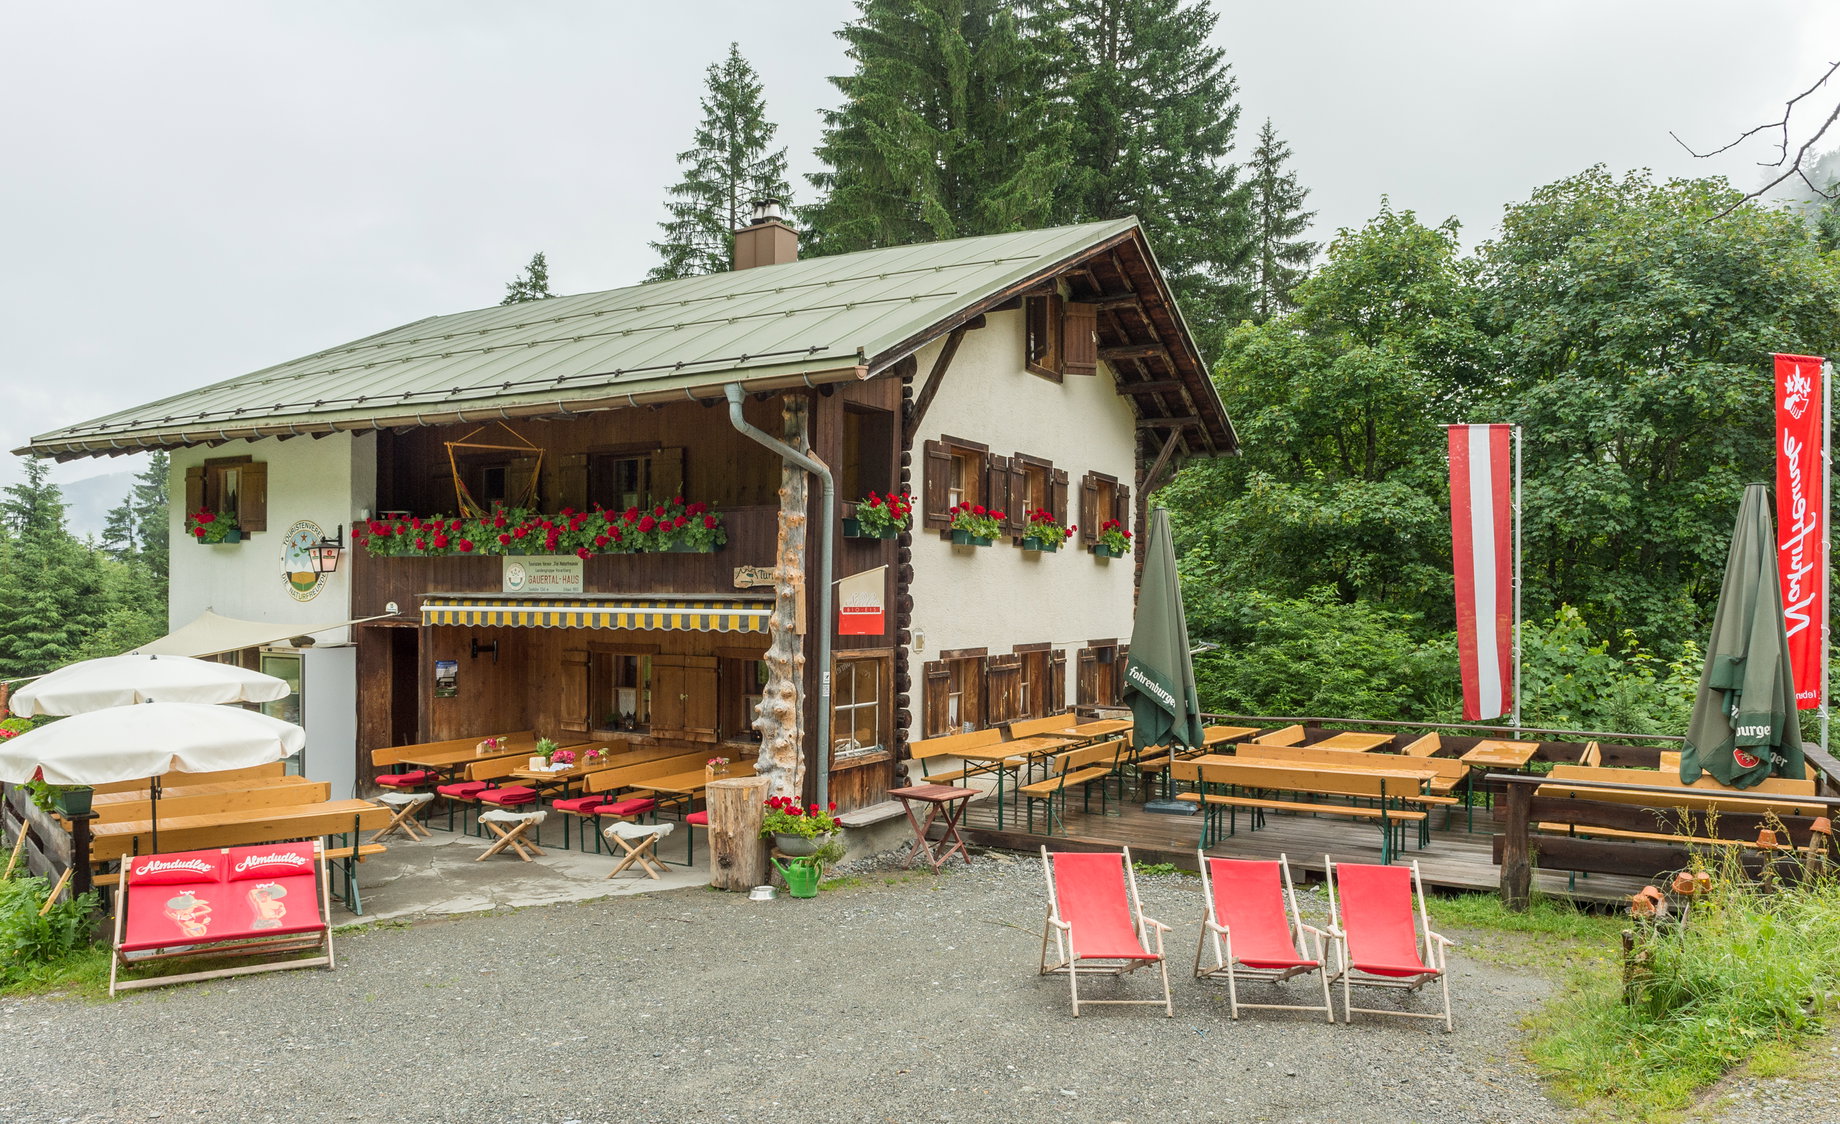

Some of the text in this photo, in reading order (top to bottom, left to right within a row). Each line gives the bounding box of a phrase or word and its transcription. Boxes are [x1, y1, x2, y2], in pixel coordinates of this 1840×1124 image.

[283, 522, 323, 546] TOURISTENVEREI
[136, 859, 212, 875] Almdudler
[235, 852, 306, 872] Almdudler
